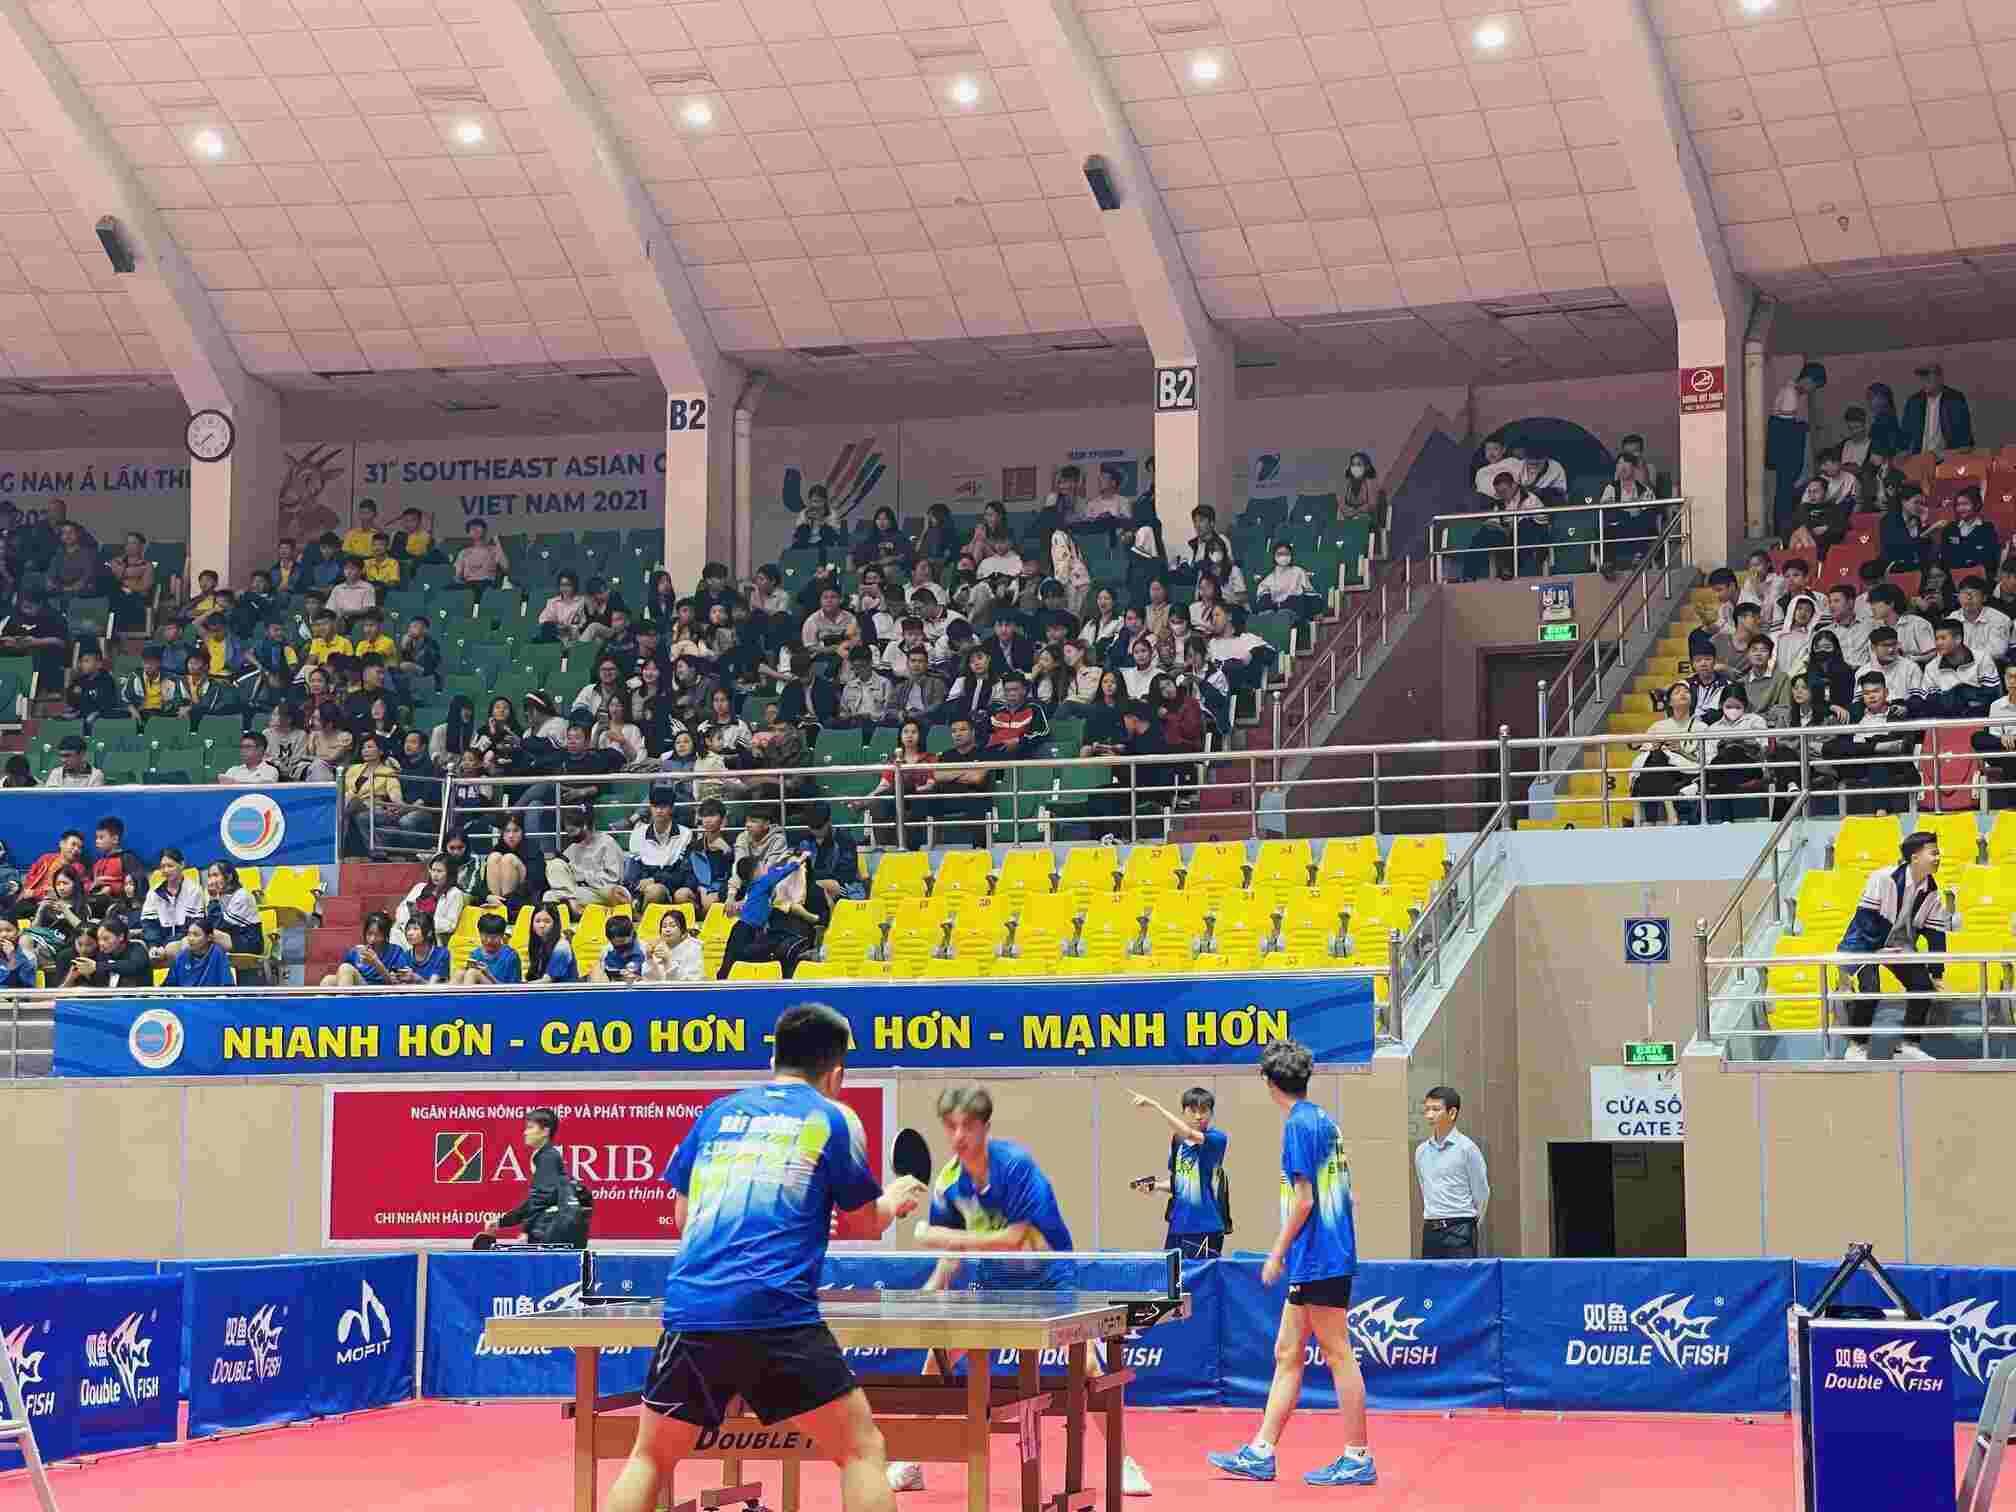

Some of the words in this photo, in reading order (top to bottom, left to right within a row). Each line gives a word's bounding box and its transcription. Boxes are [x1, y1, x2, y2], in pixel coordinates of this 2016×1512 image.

[1159, 370, 1194, 408] B2
[671, 399, 706, 430] B2
[403, 457, 558, 482] SOUTHEAST
[564, 454, 645, 478] ASIAN
[22, 471, 73, 491] NAM
[461, 494, 515, 516] VIET
[527, 491, 586, 514] NAM
[593, 489, 648, 513] 2021
[1632, 923, 1664, 957] 3
[223, 1024, 380, 1058] NHANH
[400, 1018, 492, 1057] HƠN
[540, 1021, 633, 1055] CAO
[650, 1014, 745, 1053] HƠN
[874, 1011, 972, 1050] HƠN
[1024, 1013, 1166, 1056] MẠNH
[1186, 1005, 1289, 1047] HƠN
[410, 1104, 447, 1120] NGÂN
[449, 1104, 485, 1119] HÀNG
[487, 1104, 525, 1119] NÔNG
[574, 1104, 592, 1118] VÀ
[593, 1104, 626, 1119] PHÁT
[1618, 1121, 1676, 1136] GATE
[375, 1211, 395, 1224] CHI
[398, 1210, 440, 1224] NHÁNH
[336, 1340, 391, 1365] MOFIT
[1391, 1346, 1438, 1366] FISH
[1681, 1345, 1730, 1366] FISH
[265, 1356, 282, 1377] FISH
[80, 1376, 121, 1407] Double
[137, 1375, 160, 1401] FISH
[1824, 1372, 1883, 1390] Double
[1908, 1378, 1944, 1391] FISH
[26, 1391, 55, 1417] FISH
